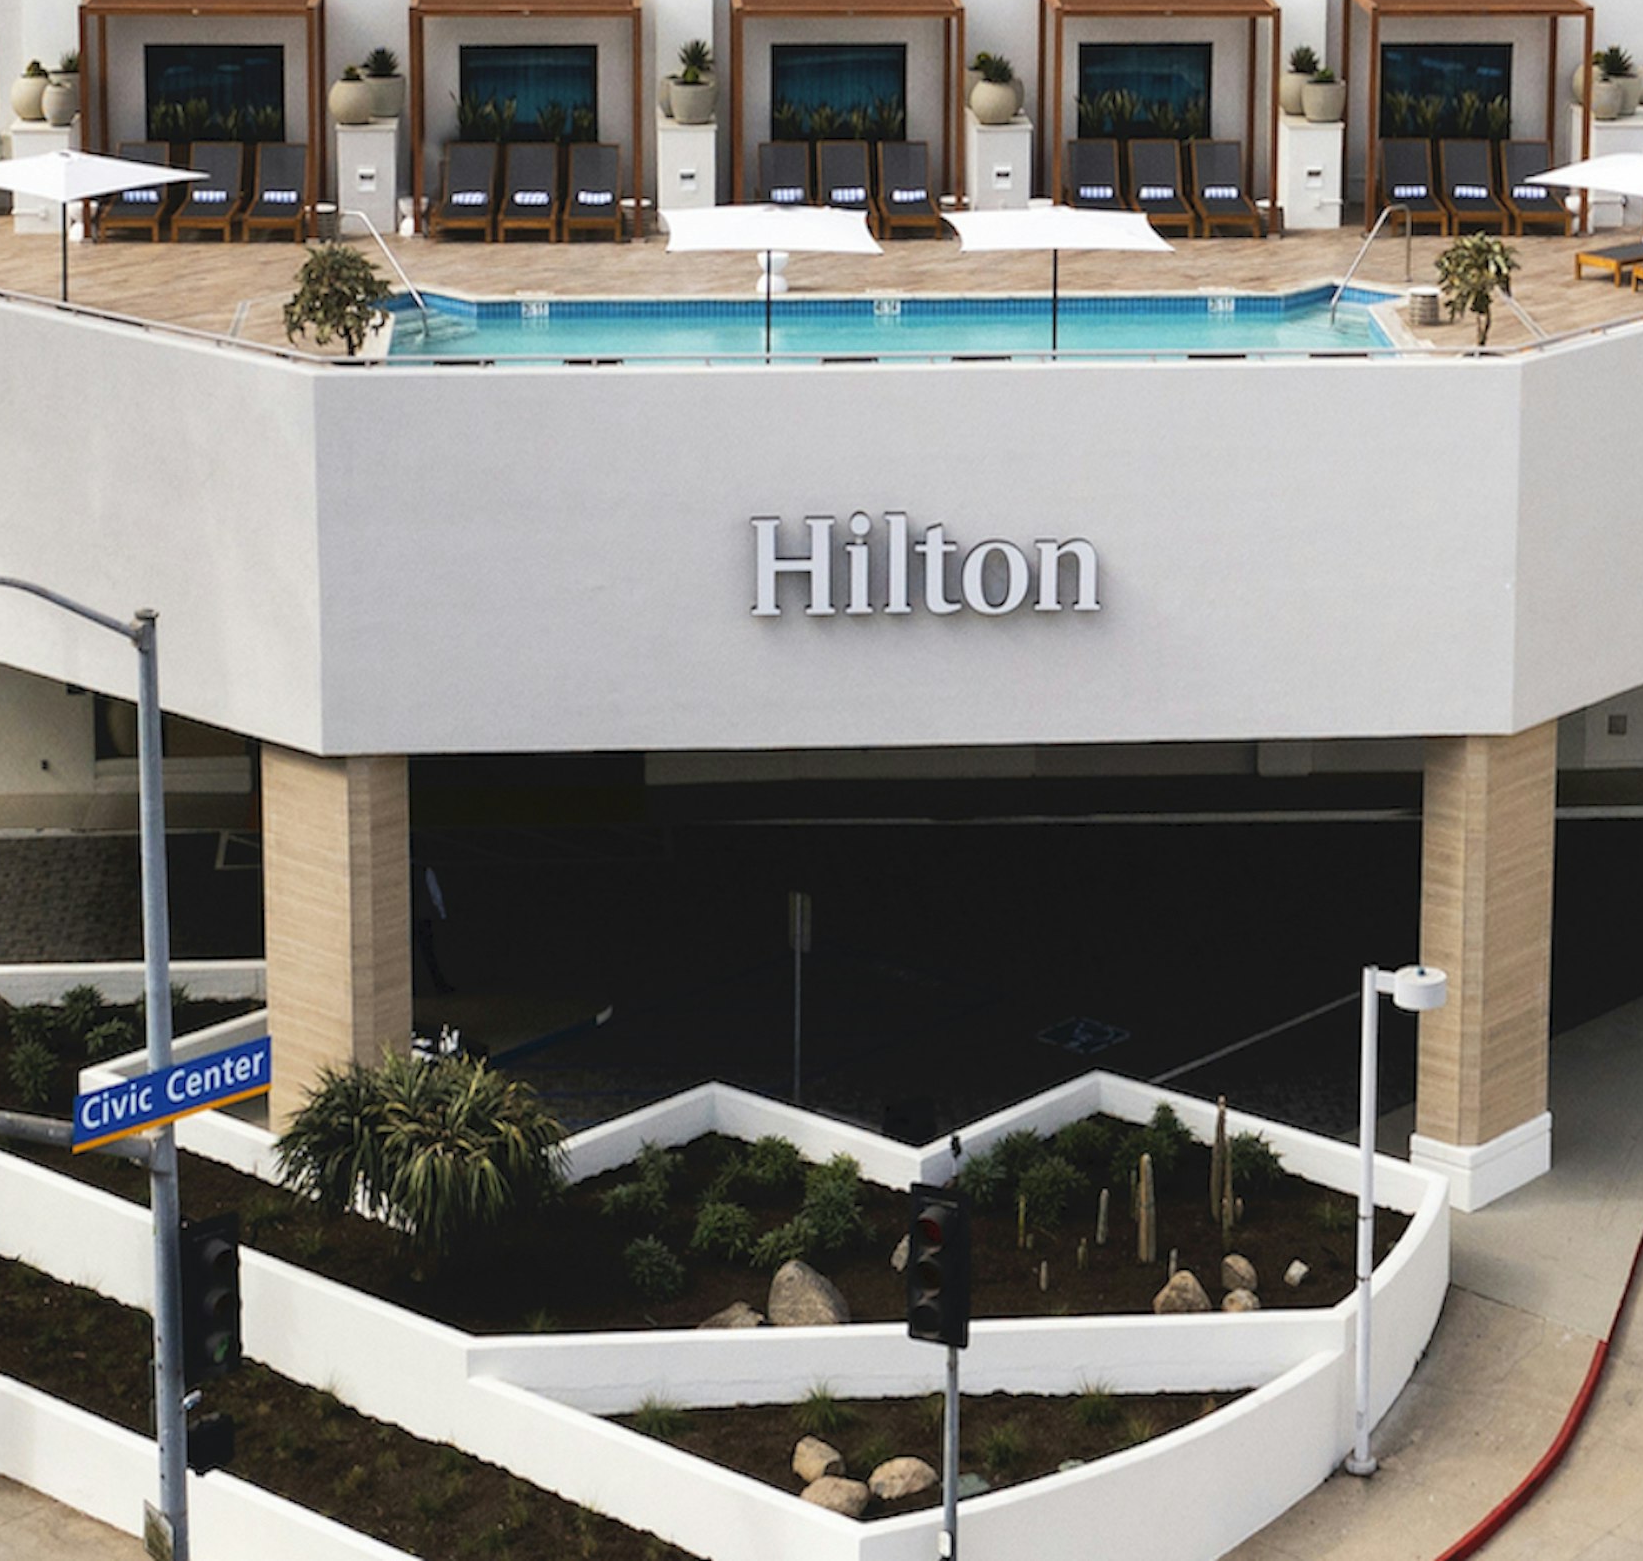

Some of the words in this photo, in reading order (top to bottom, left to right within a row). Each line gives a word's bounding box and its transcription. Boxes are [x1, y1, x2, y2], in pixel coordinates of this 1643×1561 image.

[750, 510, 1101, 616] Hilton
[81, 1081, 153, 1129] Civic
[165, 1050, 264, 1103] Center
